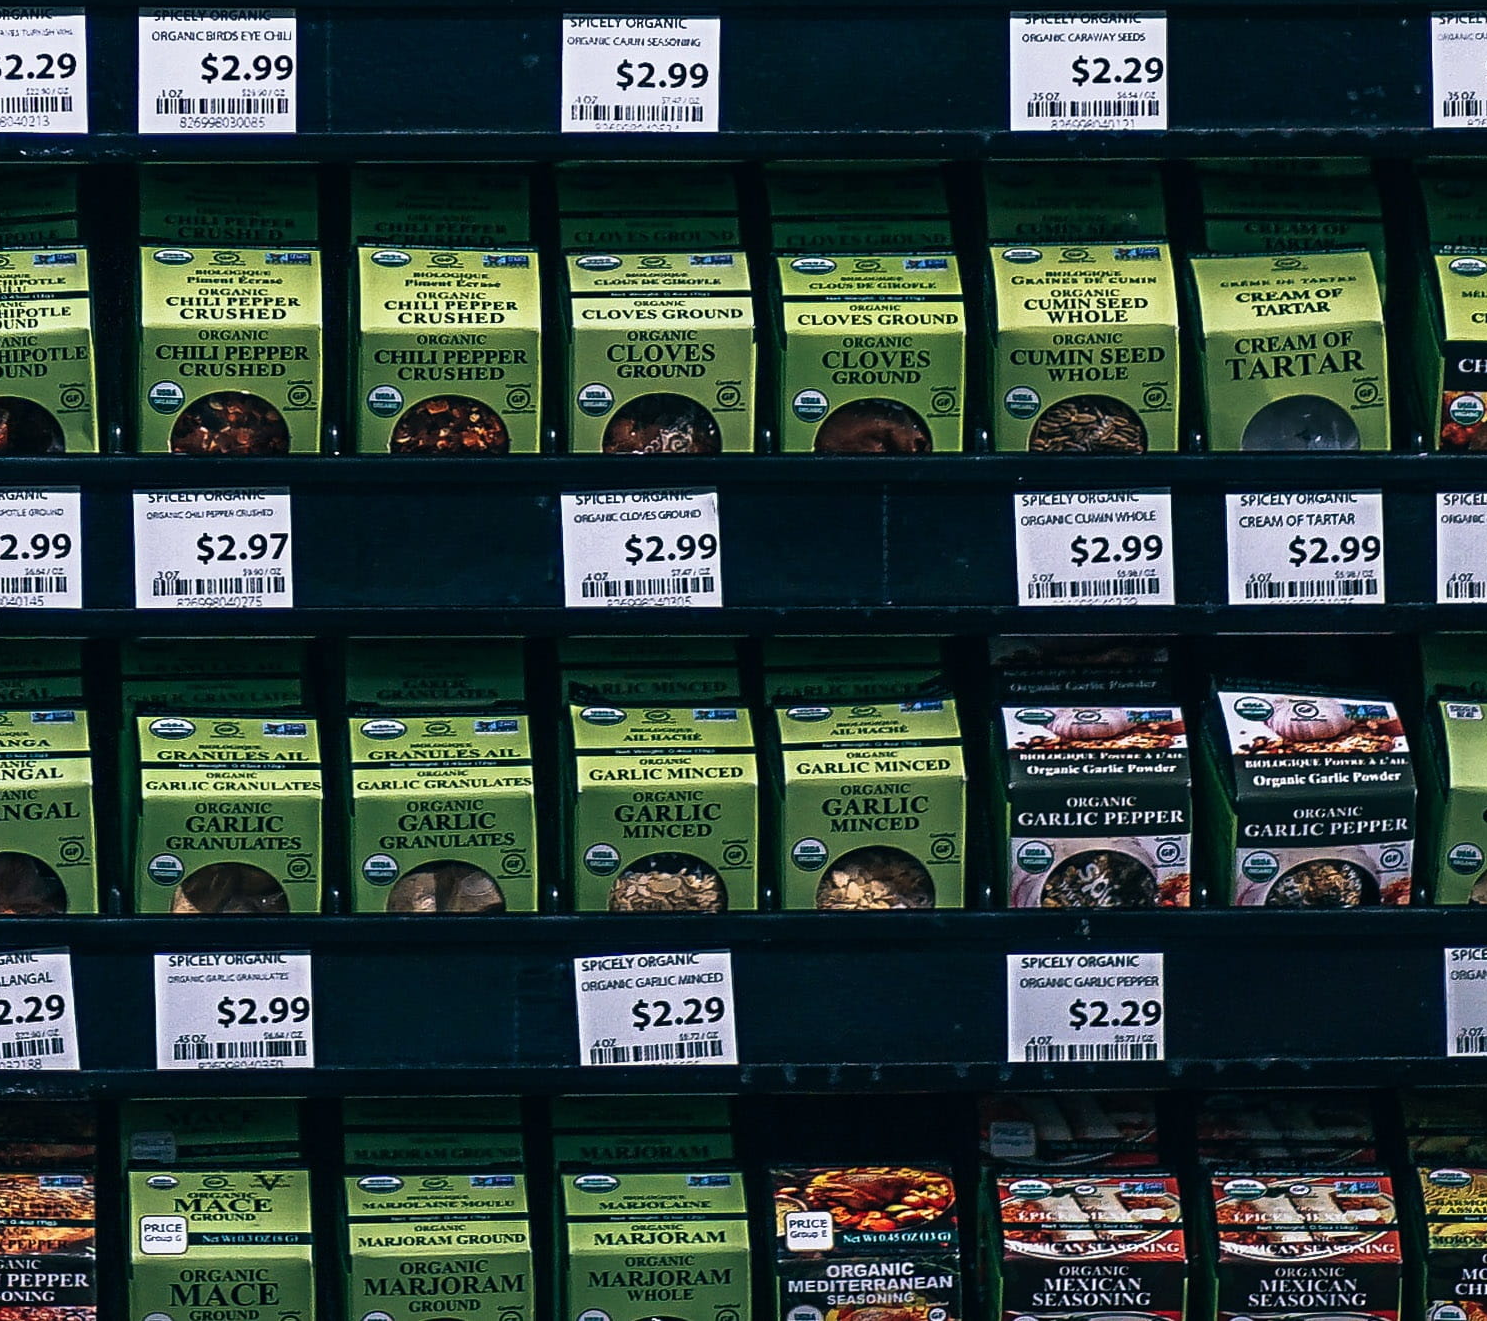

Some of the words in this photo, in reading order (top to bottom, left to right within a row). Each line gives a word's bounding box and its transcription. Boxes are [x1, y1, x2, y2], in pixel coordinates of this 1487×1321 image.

[1235, 334, 1312, 354] CREAM
[1317, 331, 1348, 349] OF
[398, 367, 504, 380] CRUSHED
[1226, 350, 1361, 382] TARTAR
[1018, 812, 1098, 825] GARLIC
[1105, 810, 1184, 824] PEPPER
[169, 1283, 279, 1306] MACE
[363, 1274, 525, 1296] MARJORAM
[789, 1276, 952, 1292] MEDITERRANEAN
